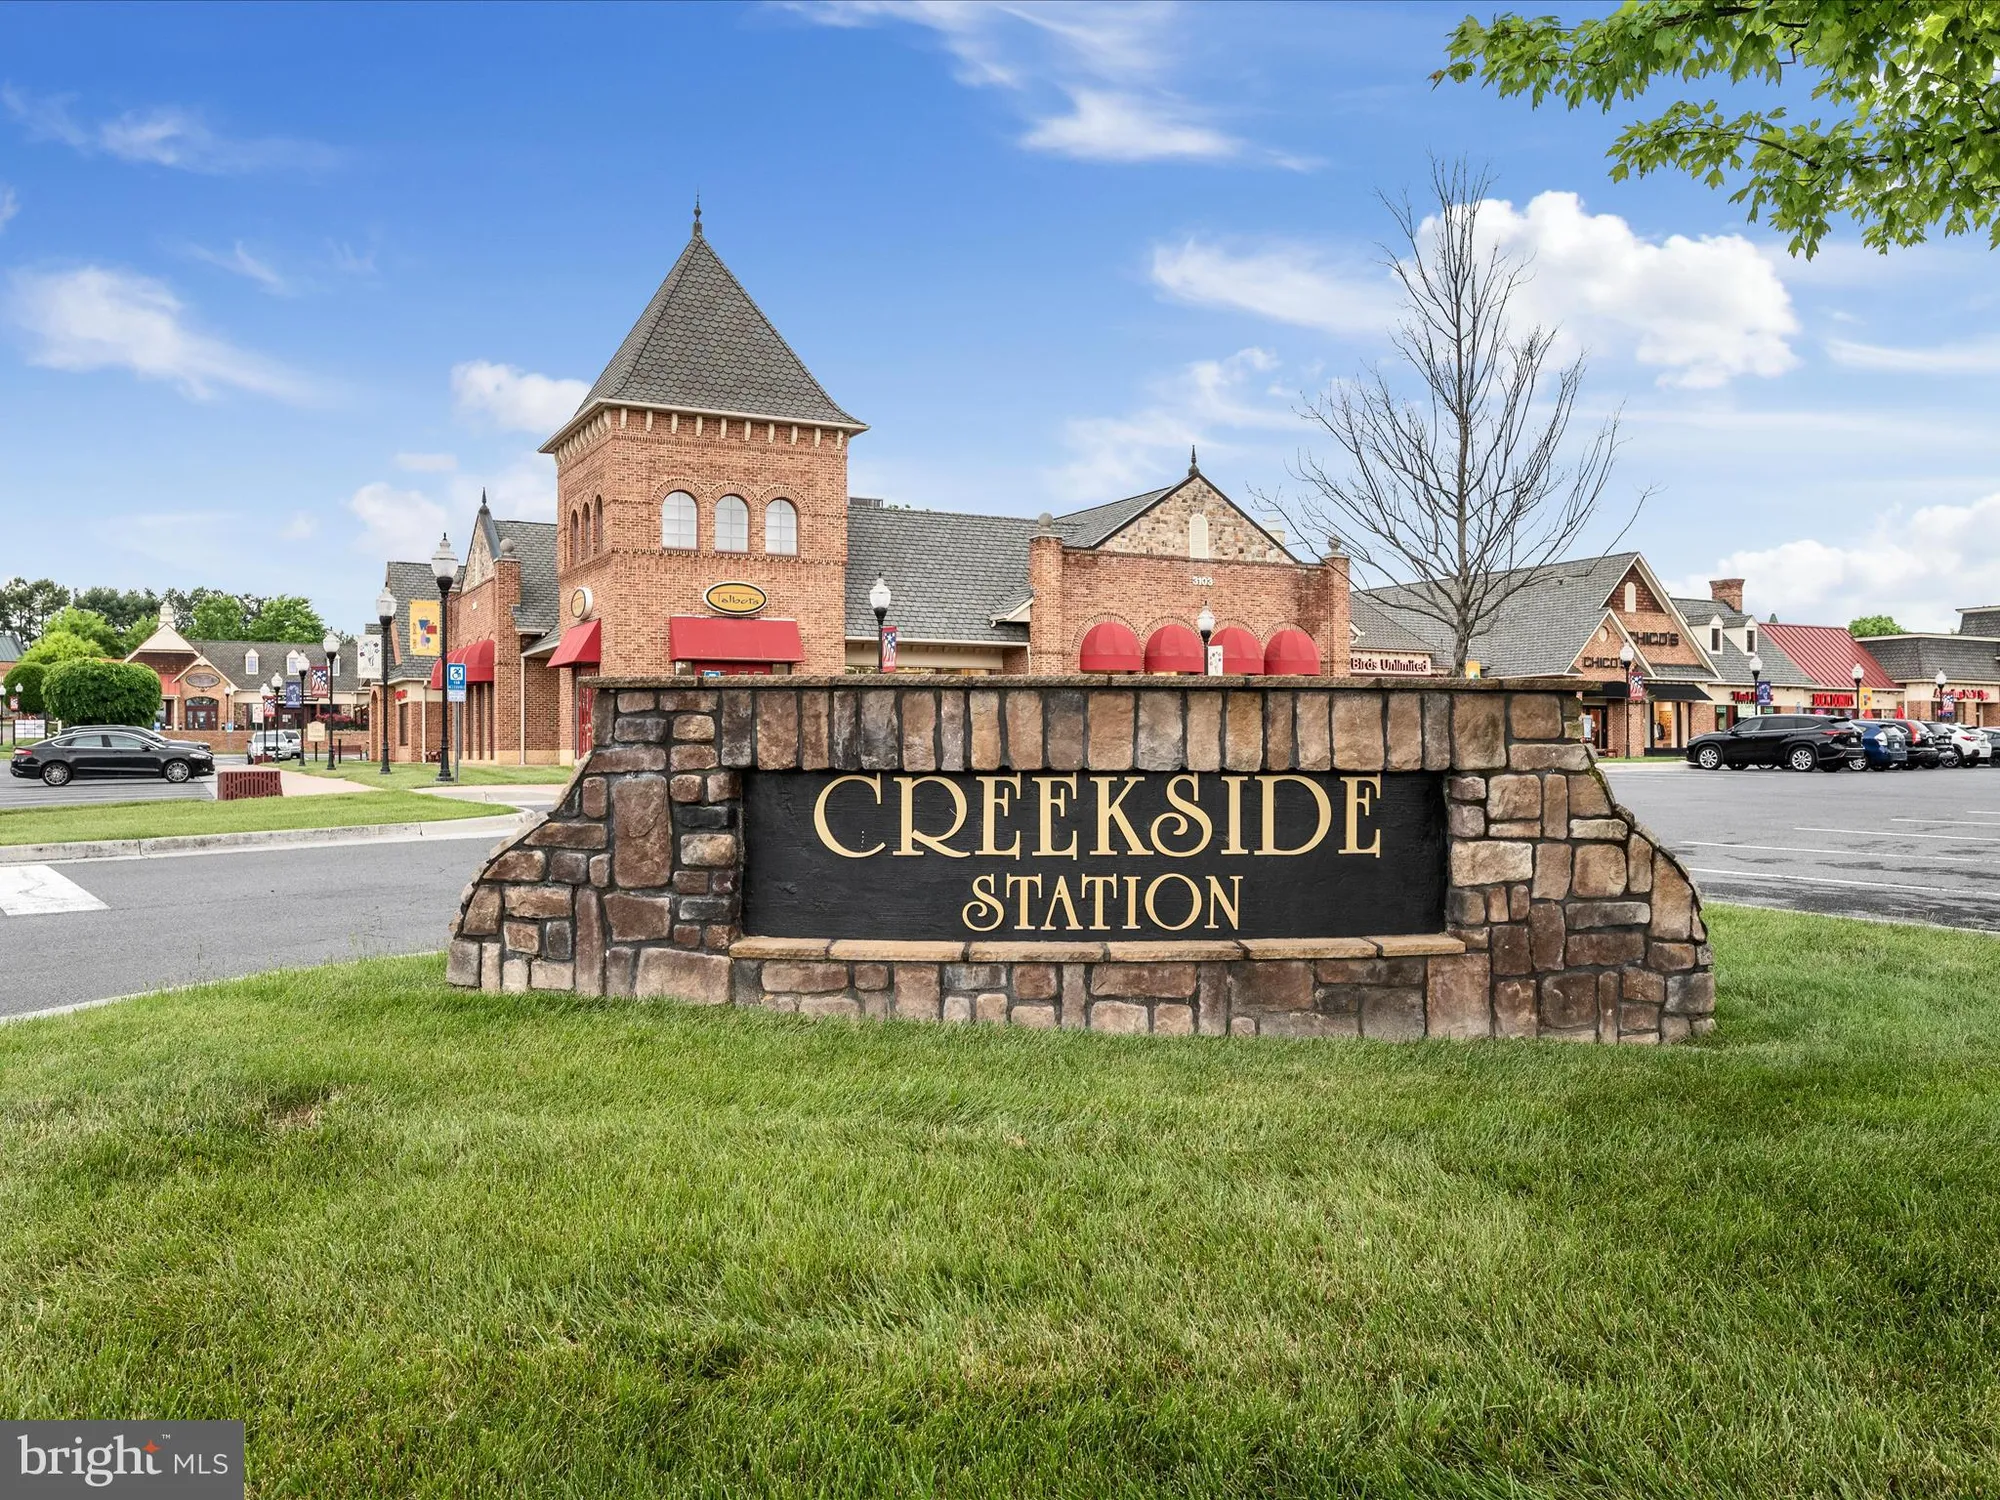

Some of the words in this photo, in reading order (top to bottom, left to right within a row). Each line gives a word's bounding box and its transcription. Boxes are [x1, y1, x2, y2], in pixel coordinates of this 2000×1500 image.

[1192, 576, 1213, 586] 3103
[712, 592, 761, 605] Talbots
[1350, 658, 1378, 670] Birds
[1380, 659, 1427, 672] Unlimited
[1812, 693, 1832, 707] DUCK
[813, 772, 1382, 860] CREEKSIDE
[962, 873, 1243, 931] STATION
